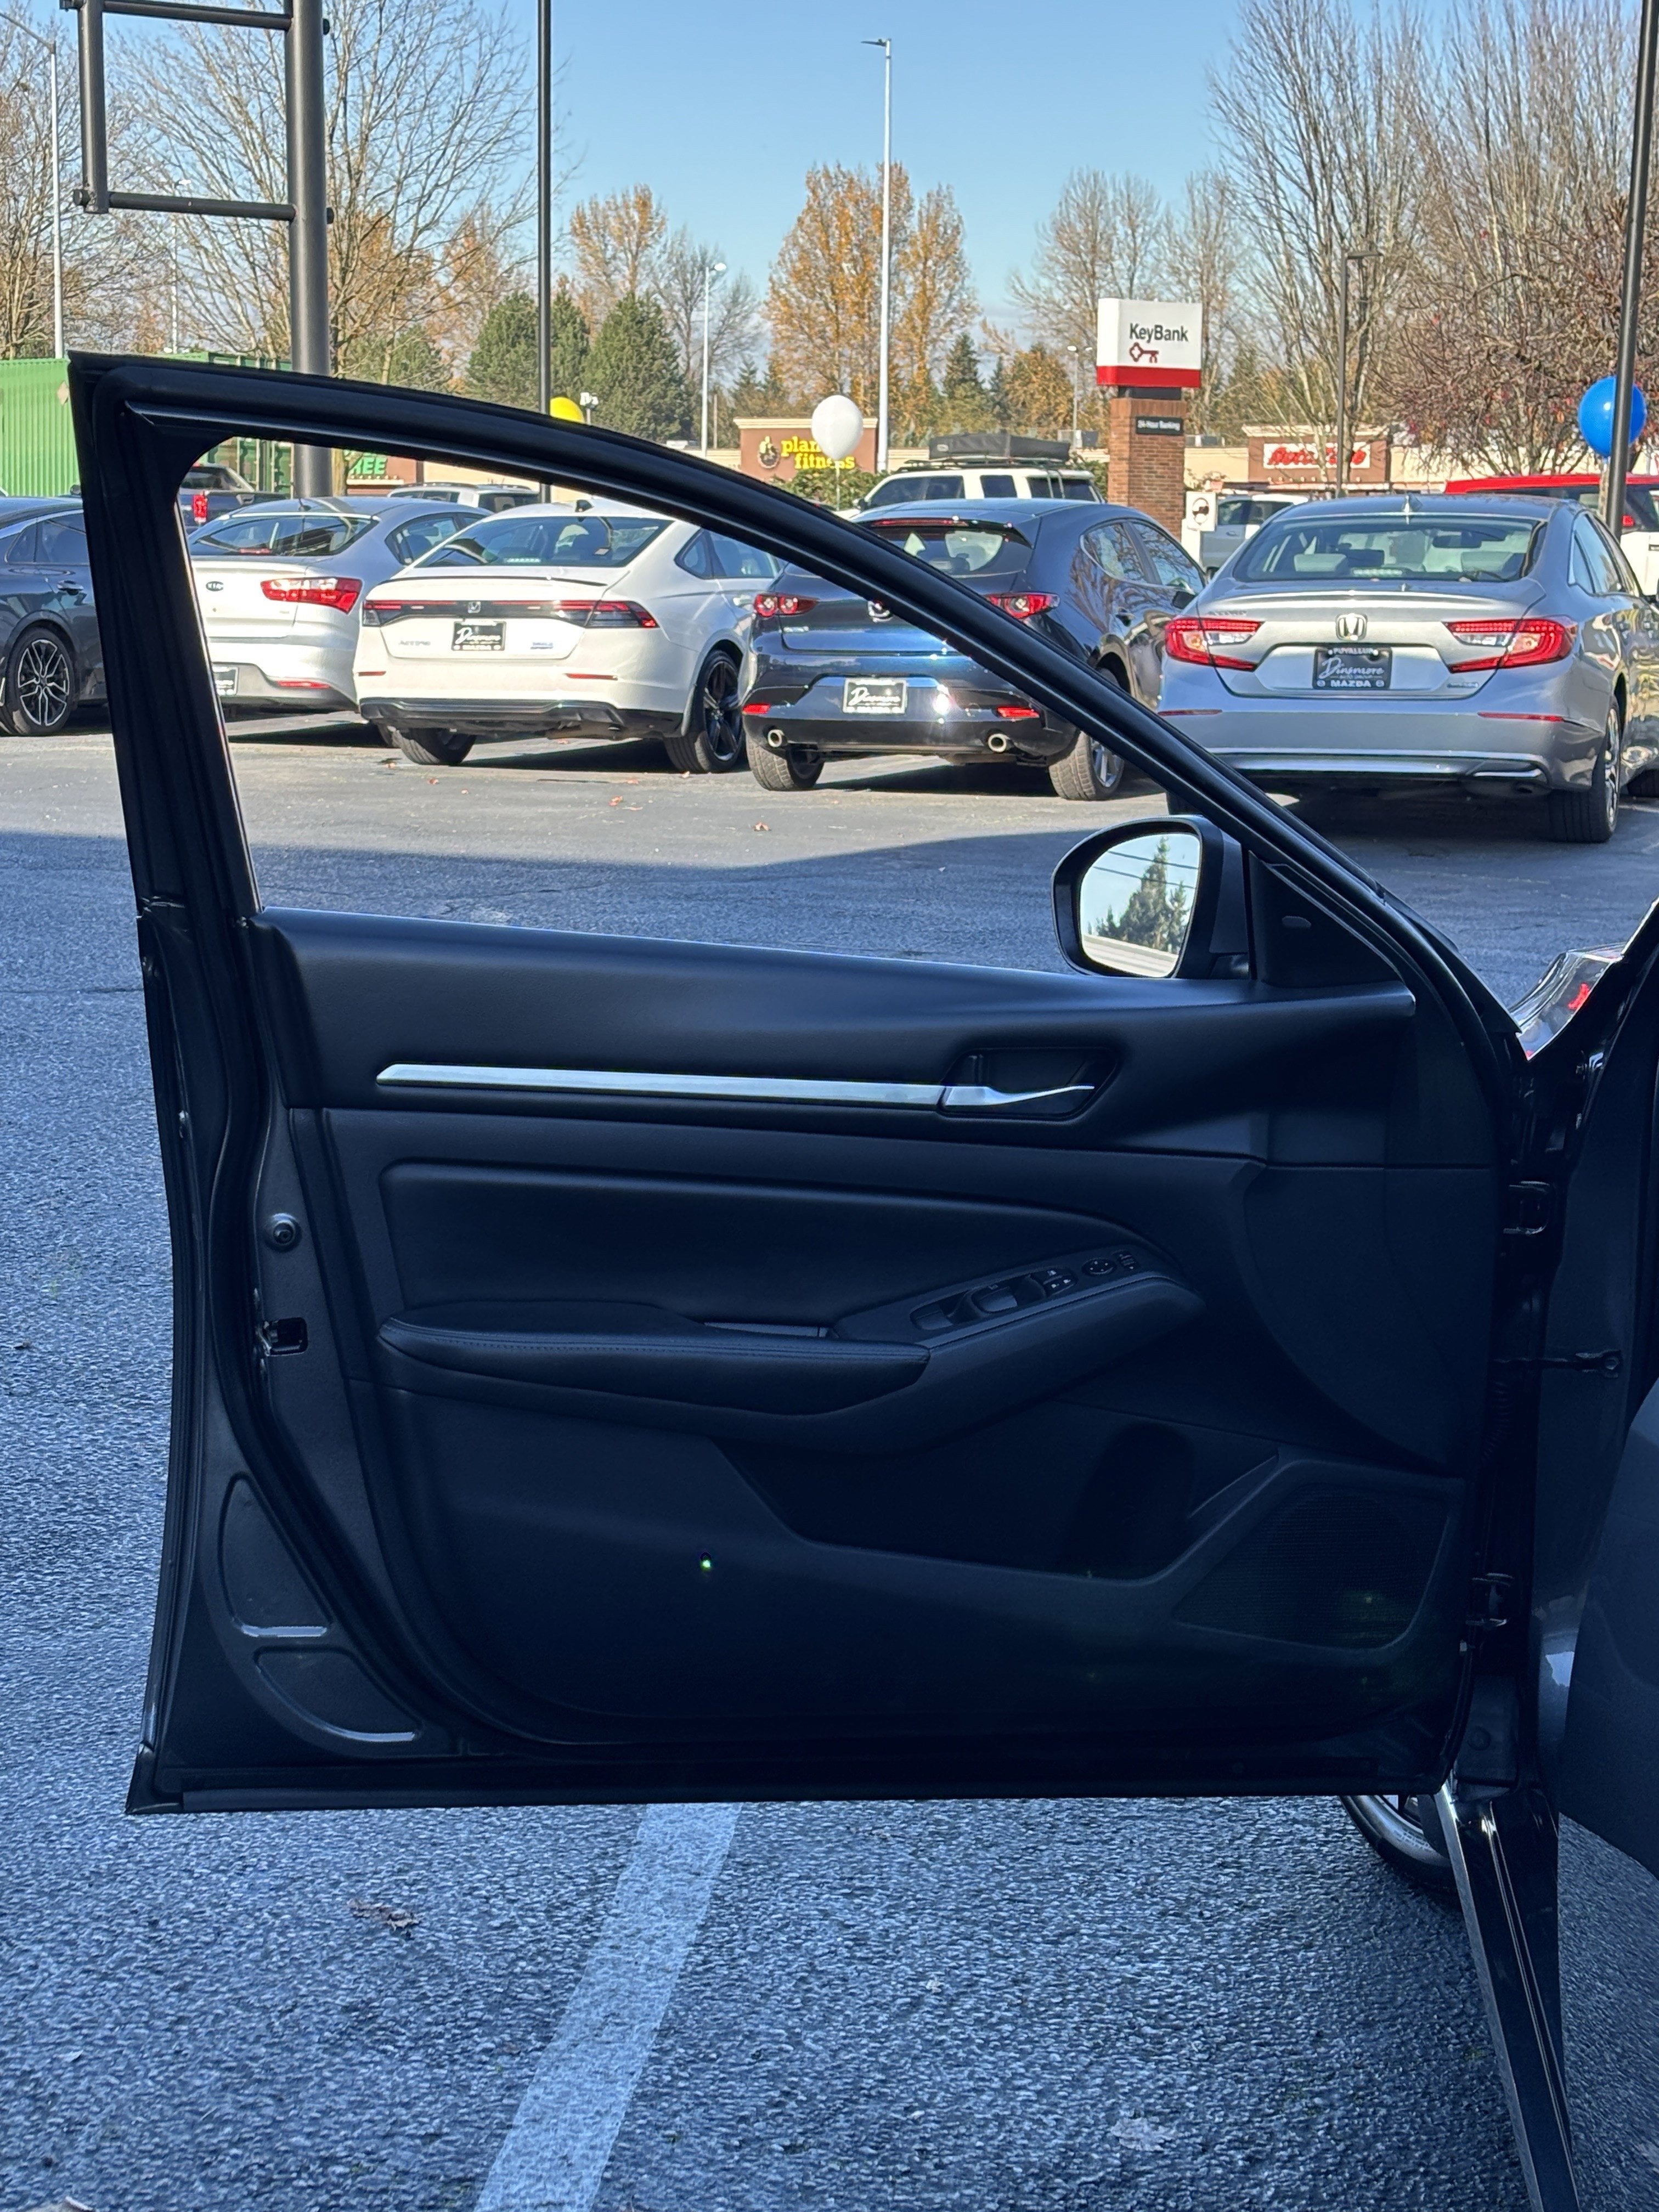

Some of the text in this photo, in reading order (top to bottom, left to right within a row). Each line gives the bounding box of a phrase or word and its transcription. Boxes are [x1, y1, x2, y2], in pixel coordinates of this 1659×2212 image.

[1130, 323, 1189, 343] KeyBank
[781, 436, 822, 457] plan
[1318, 656, 1385, 679] Dinsmore
